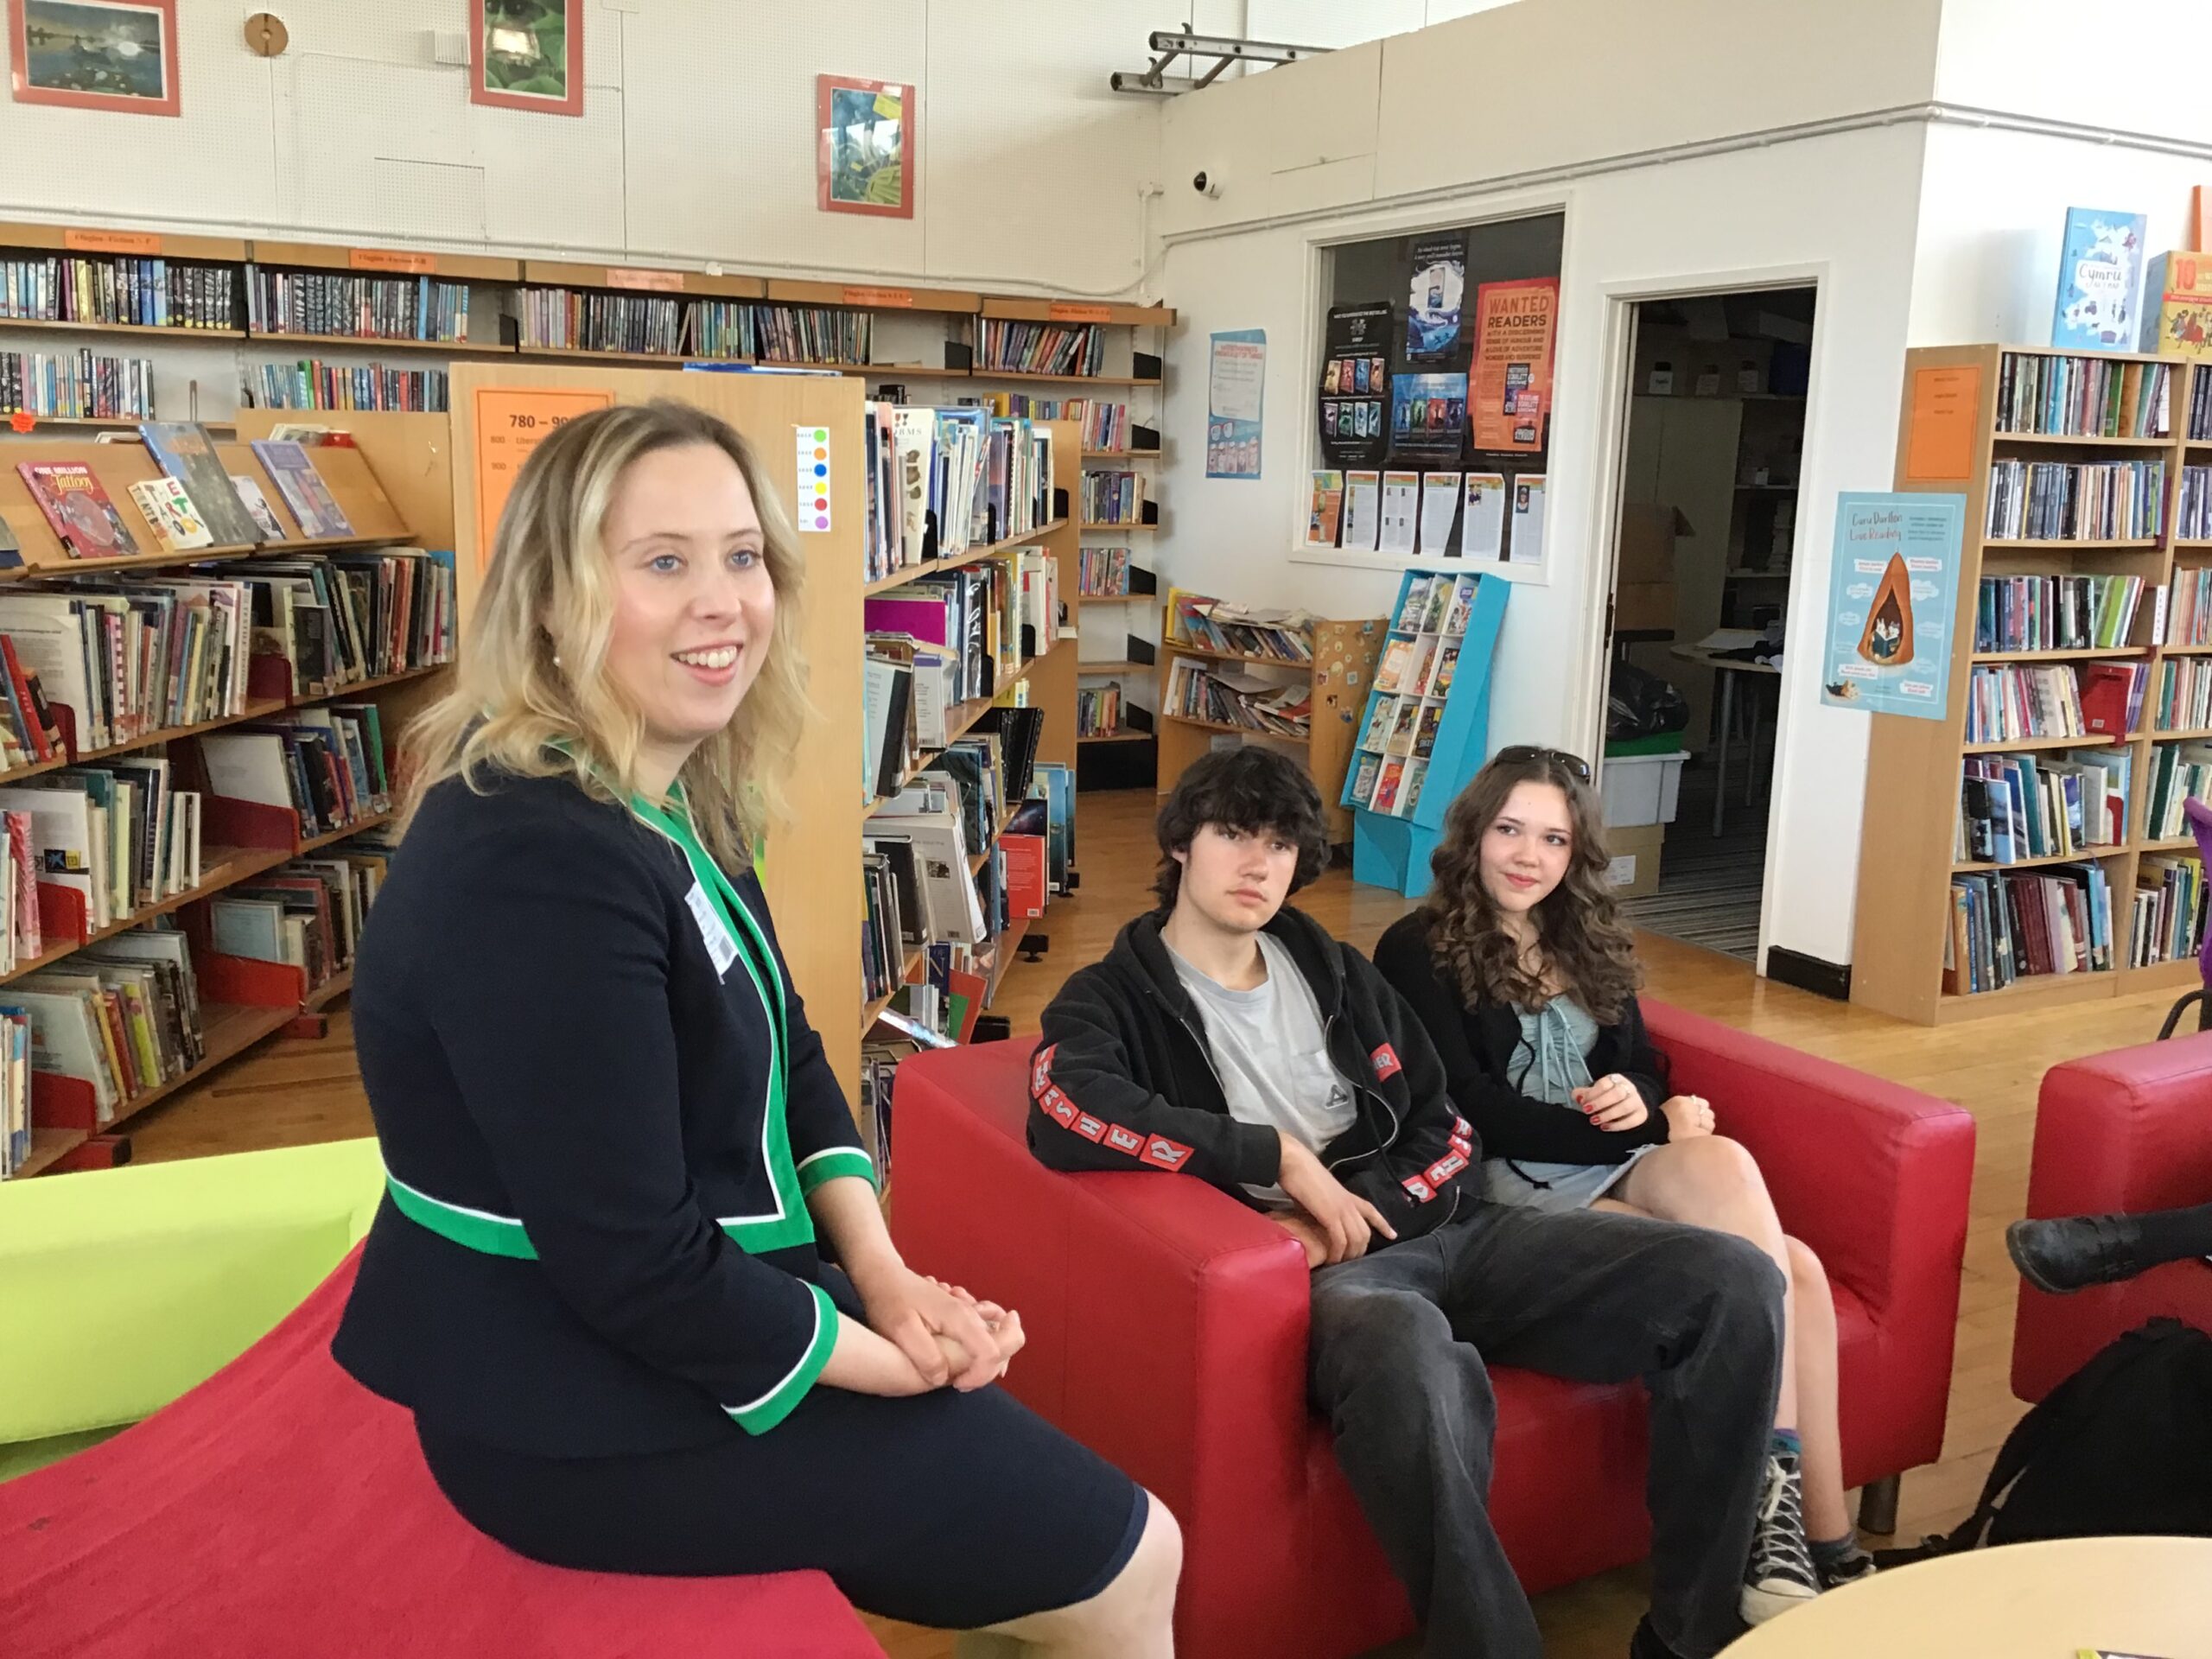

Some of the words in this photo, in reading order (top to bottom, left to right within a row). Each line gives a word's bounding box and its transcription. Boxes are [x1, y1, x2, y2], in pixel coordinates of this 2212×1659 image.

[2079, 263, 2121, 284] Cymru
[2176, 259, 2196, 289] 10
[1489, 296, 1549, 314] WANTED
[1487, 315, 1547, 328] READERS
[509, 415, 536, 428] 780
[51, 474, 93, 495] Tattoos
[1873, 511, 1903, 525] Darllen
[1850, 528, 1866, 541] Love
[1869, 527, 1901, 542] Reading
